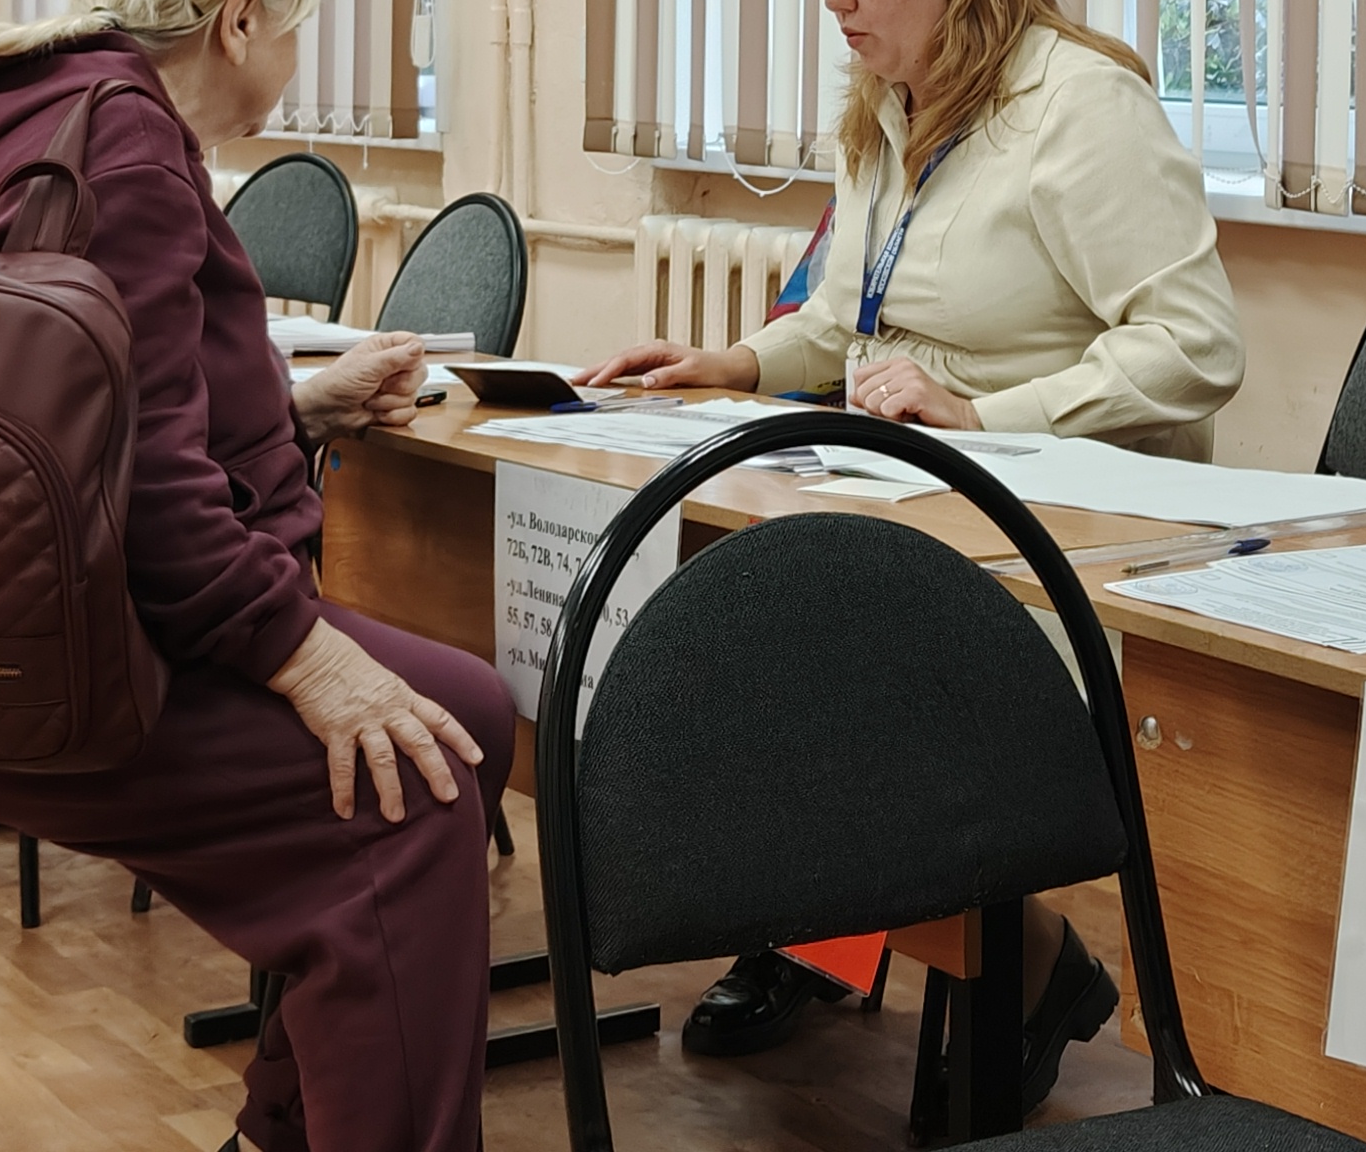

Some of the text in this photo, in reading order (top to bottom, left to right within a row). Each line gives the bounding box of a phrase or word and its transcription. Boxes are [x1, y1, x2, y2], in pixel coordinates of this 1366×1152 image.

[507, 511, 526, 529] -ул.
[507, 537, 529, 563] 72Б,
[531, 544, 554, 571] 72В,
[557, 552, 572, 576] 74,
[507, 606, 522, 627] 55,
[523, 611, 538, 634] 57,
[508, 648, 526, 665] -ул.
